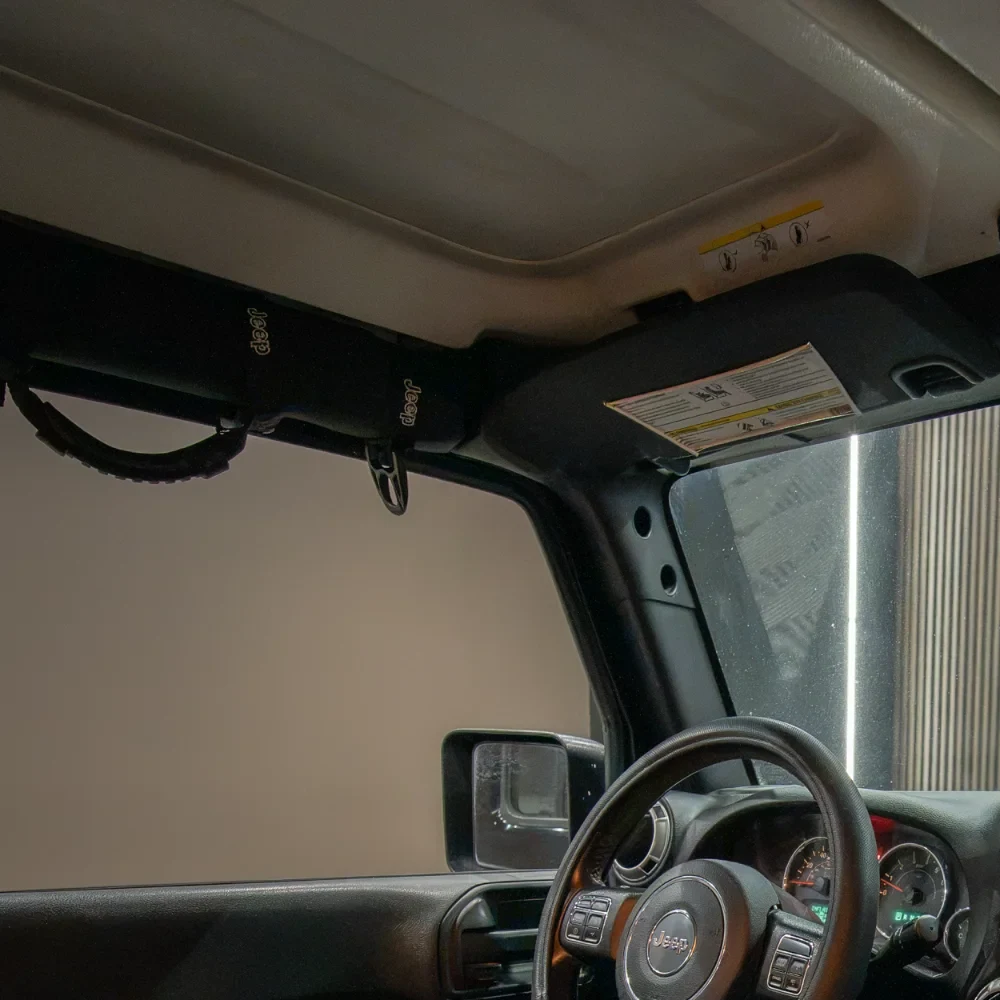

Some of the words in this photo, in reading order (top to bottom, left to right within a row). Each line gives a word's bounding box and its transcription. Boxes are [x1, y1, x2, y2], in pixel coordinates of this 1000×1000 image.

[247, 308, 270, 355] Jeep
[400, 379, 422, 426] Jeep
[652, 930, 689, 955] Jeep
